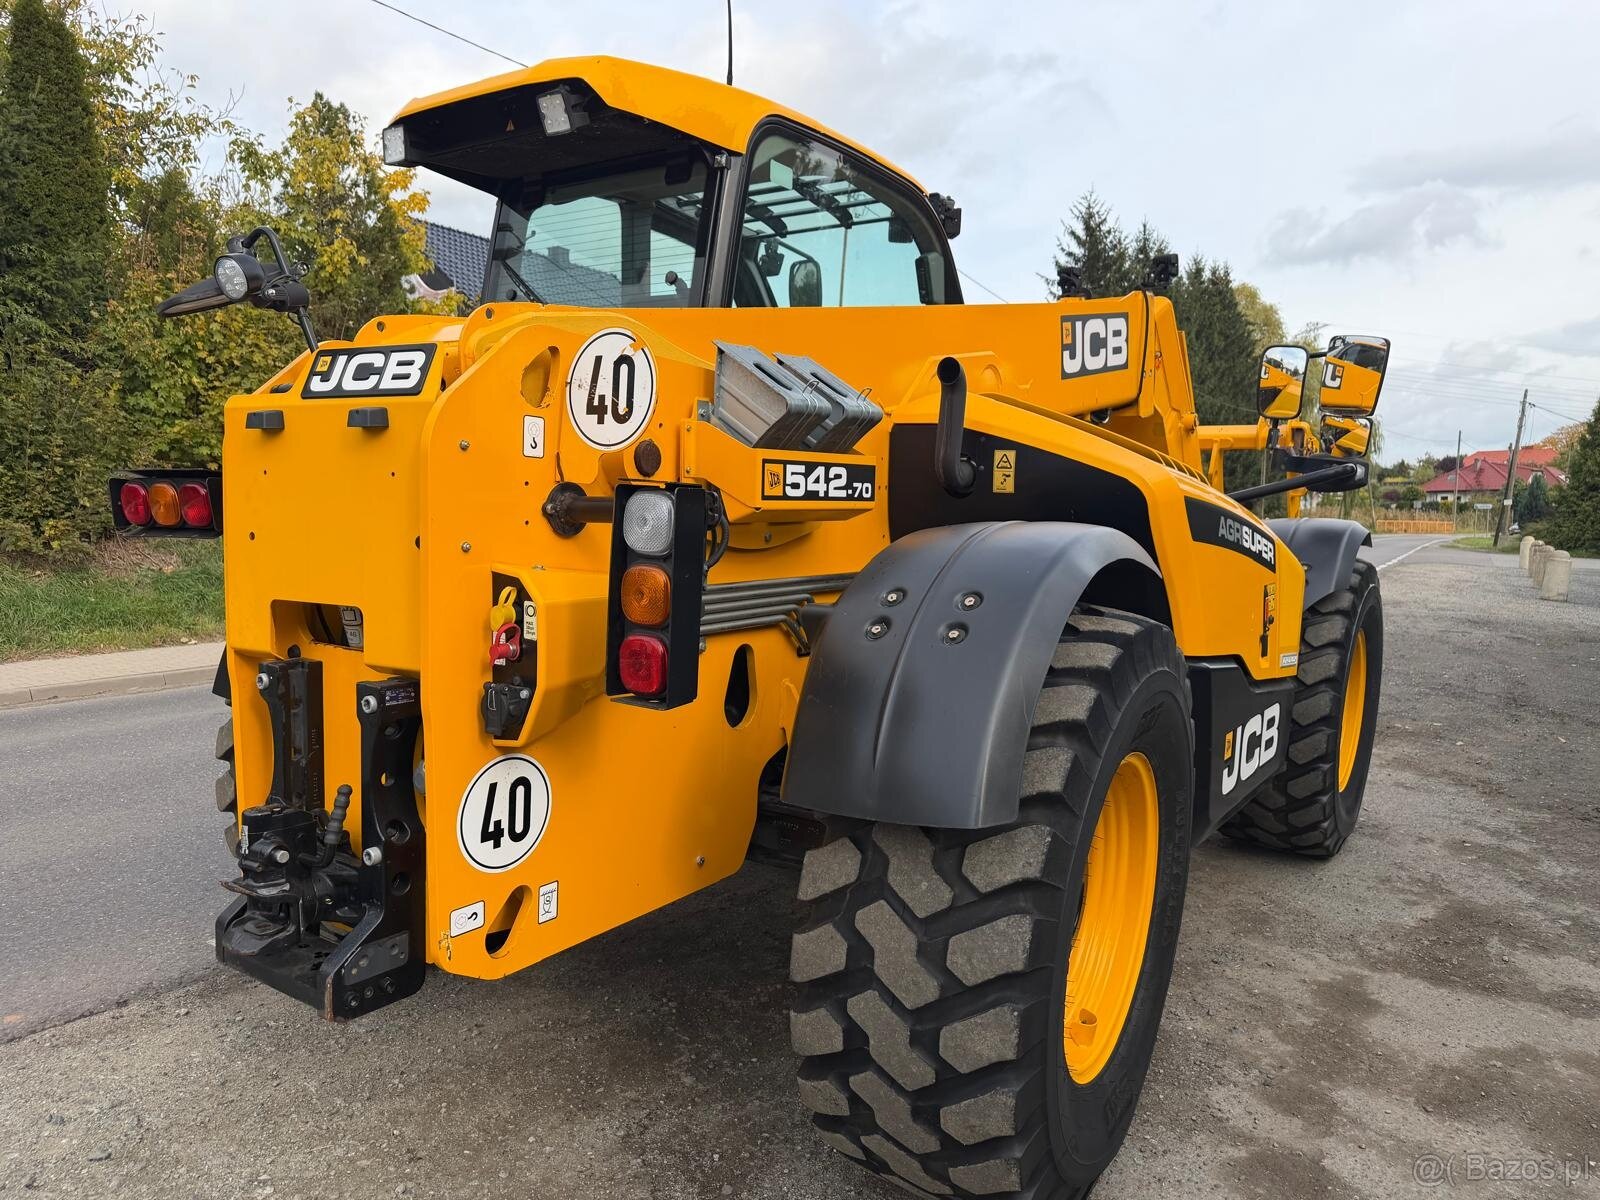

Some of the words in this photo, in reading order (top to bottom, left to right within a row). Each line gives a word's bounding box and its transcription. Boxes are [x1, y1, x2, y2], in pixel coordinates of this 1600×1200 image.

[309, 350, 426, 392] JCB
[1062, 318, 1128, 374] JCB
[586, 353, 636, 425] 40
[1222, 702, 1281, 795] JCB
[480, 775, 532, 850] 40
